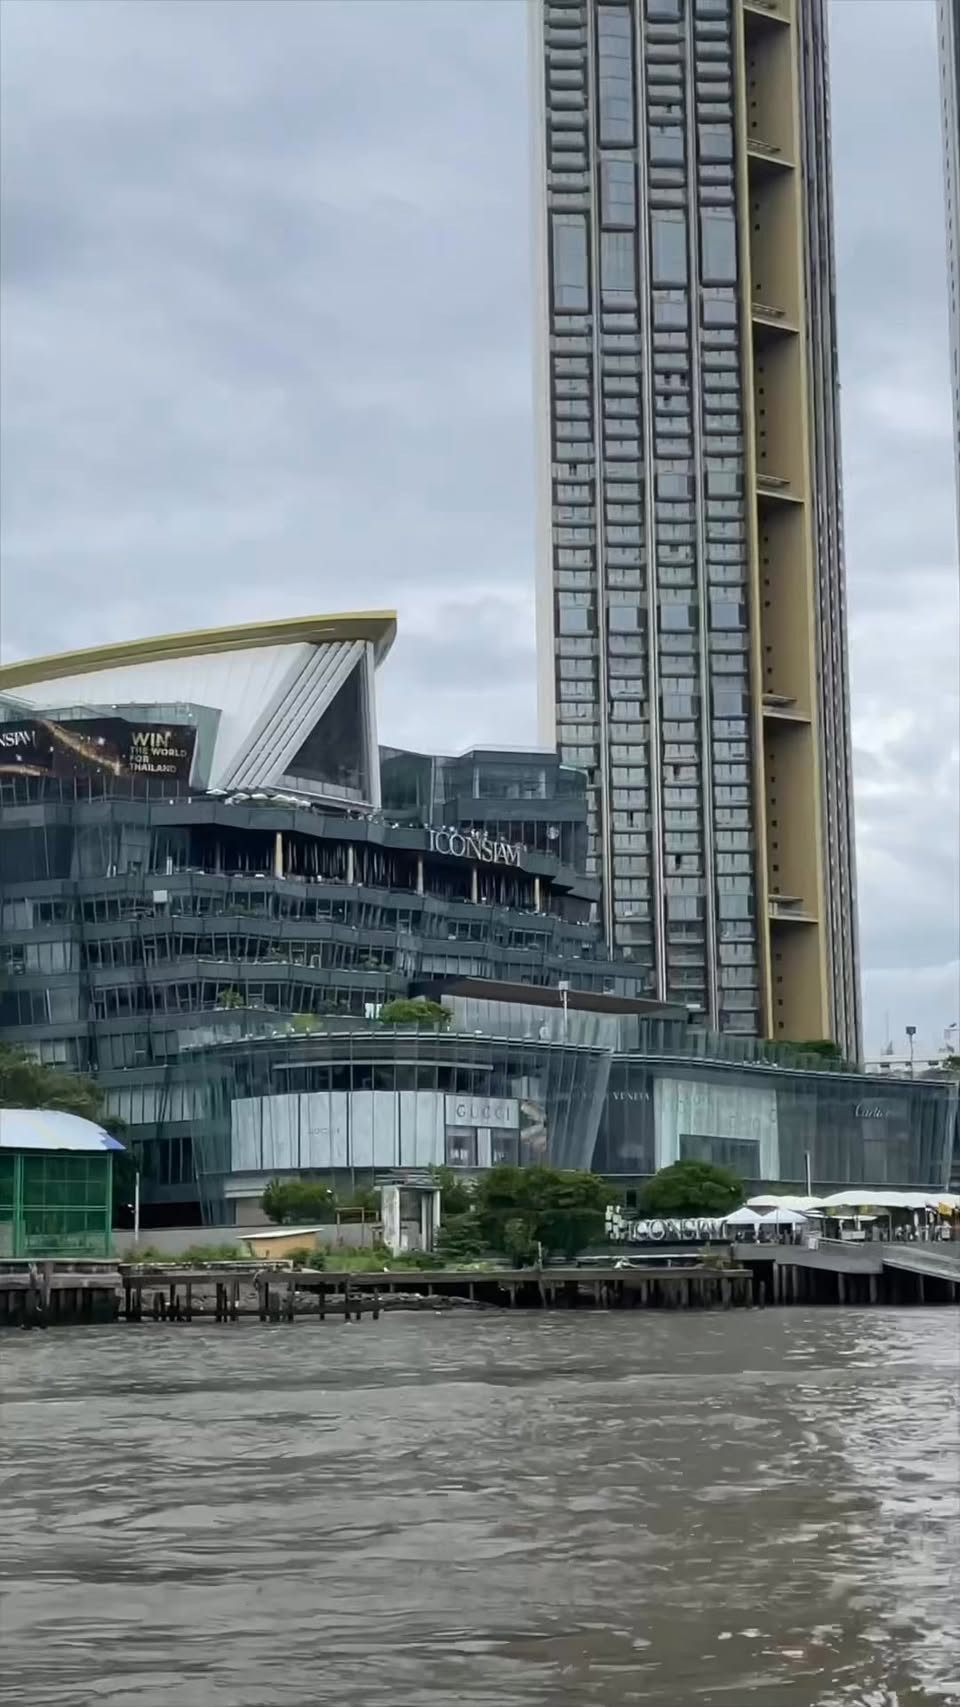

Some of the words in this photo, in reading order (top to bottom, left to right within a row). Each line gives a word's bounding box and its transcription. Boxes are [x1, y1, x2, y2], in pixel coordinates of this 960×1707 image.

[131, 732, 169, 747] WIN
[130, 746, 149, 755] THE
[151, 747, 187, 757] WORLD
[130, 755, 149, 763] FOR
[130, 763, 177, 773] THAILAND
[429, 830, 521, 867] ICONSIAM
[456, 1104, 510, 1121] GUCCI
